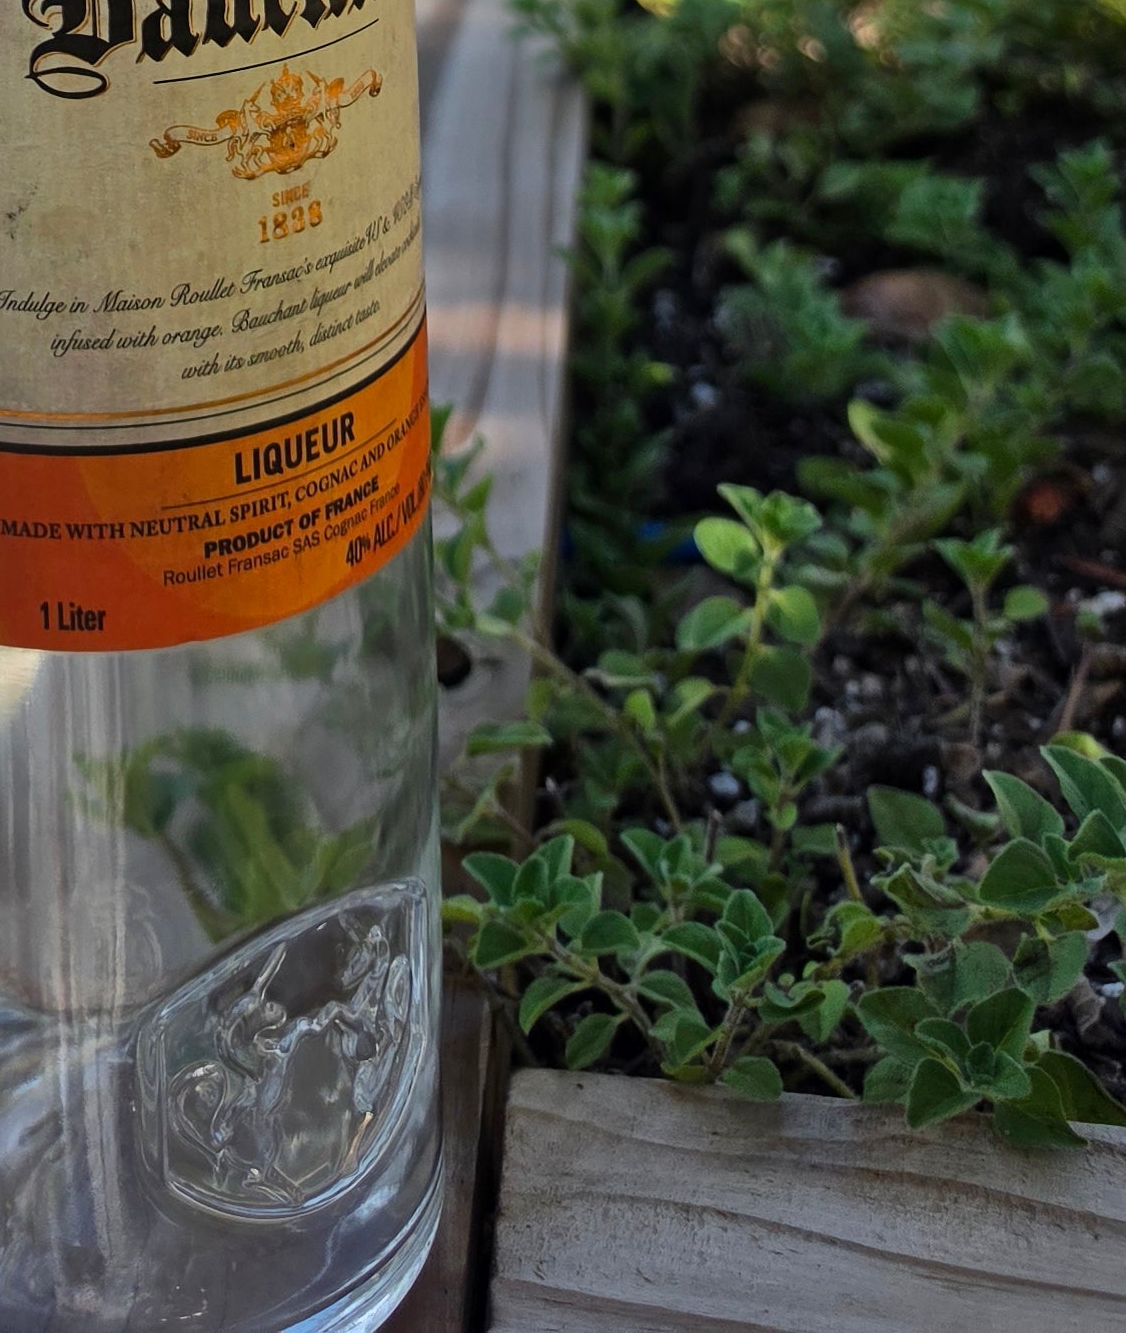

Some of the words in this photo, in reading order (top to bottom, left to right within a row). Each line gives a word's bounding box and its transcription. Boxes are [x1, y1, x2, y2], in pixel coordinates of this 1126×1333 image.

[258, 200, 323, 244] 1838
[272, 182, 310, 208] SINCE
[69, 297, 88, 314] in
[93, 289, 165, 314] Maison
[170, 276, 236, 308] Roullet
[240, 257, 313, 294] Fransac's
[315, 237, 366, 274] exquisite
[50, 329, 114, 358] infused
[116, 325, 158, 350] with
[162, 324, 222, 349] orange.
[231, 299, 308, 333] Bauchant
[309, 286, 352, 316] liqueur
[182, 352, 222, 380] with
[224, 355, 245, 373] its
[247, 330, 304, 367] smooth,
[309, 311, 354, 347] distinct
[234, 411, 356, 485] LIQUEUR
[1, 518, 61, 540] MADE
[65, 522, 125, 541] WITH
[129, 507, 225, 538] NEUTRAL
[229, 490, 292, 524] SPIRIT,
[294, 459, 358, 503] COGNAC
[359, 441, 386, 473] AND
[203, 519, 294, 559] PRODUCT
[299, 507, 322, 531] OF
[325, 475, 380, 521] FRANCE
[163, 561, 224, 587] Roullet
[228, 545, 290, 574] Fransac
[293, 534, 321, 556] SAS
[325, 509, 368, 541] Cognac
[370, 483, 401, 516] France
[345, 534, 371, 568] 40%
[40, 601, 50, 631] 1
[57, 601, 107, 632] Liter
